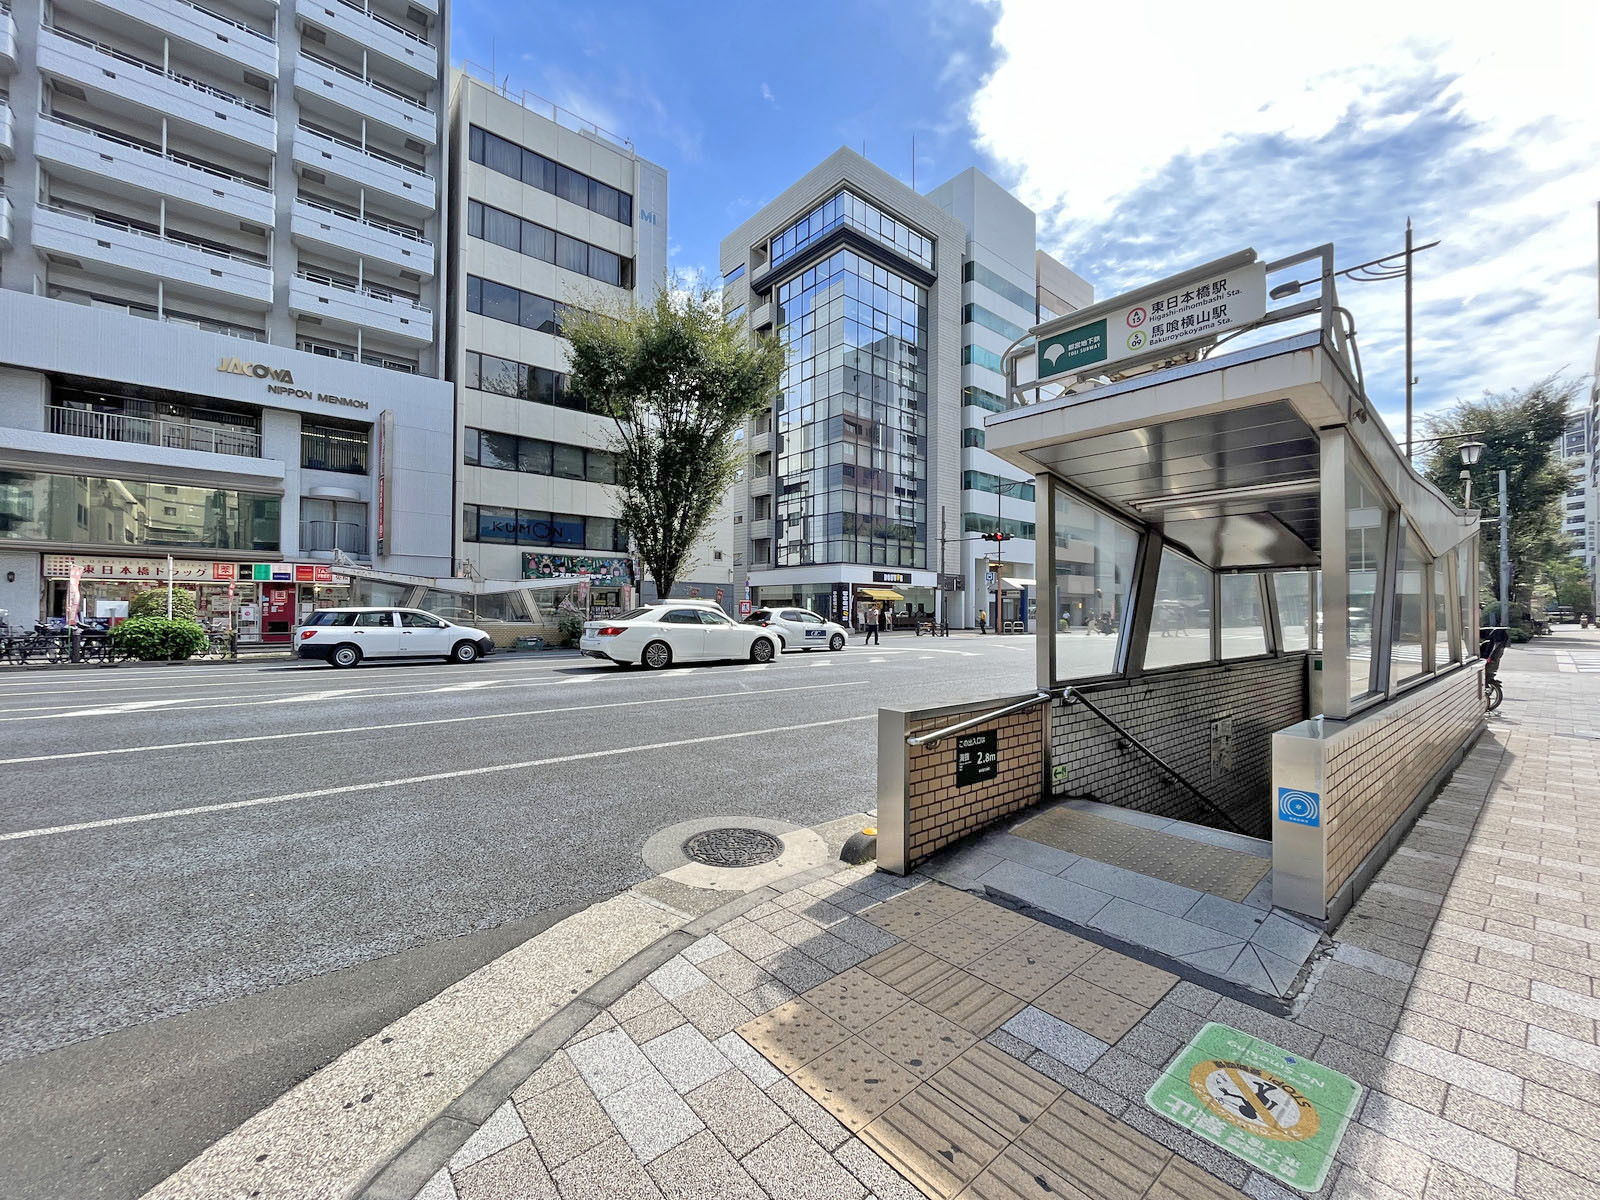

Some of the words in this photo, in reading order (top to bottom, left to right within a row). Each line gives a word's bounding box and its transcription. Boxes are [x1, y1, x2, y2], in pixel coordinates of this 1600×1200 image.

[1149, 292, 1225, 323] Higashi-nihombashi
[1226, 288, 1243, 298] Sta.
[1151, 279, 1227, 315] 東日本橋駅
[1132, 317, 1142, 325] 15
[1149, 323, 1215, 346] Bakuroyokoyama
[1217, 318, 1233, 327] Sta.
[1151, 304, 1227, 339] 馬喰横山駅
[1131, 339, 1142, 348] 09
[217, 357, 294, 384] JACOWA
[267, 384, 312, 400] NIPPON
[317, 393, 369, 410] MENMOH
[492, 520, 563, 539] KUMON
[82, 565, 207, 577] 東日本橋ドラッグ
[977, 752, 995, 764] 2.8m
